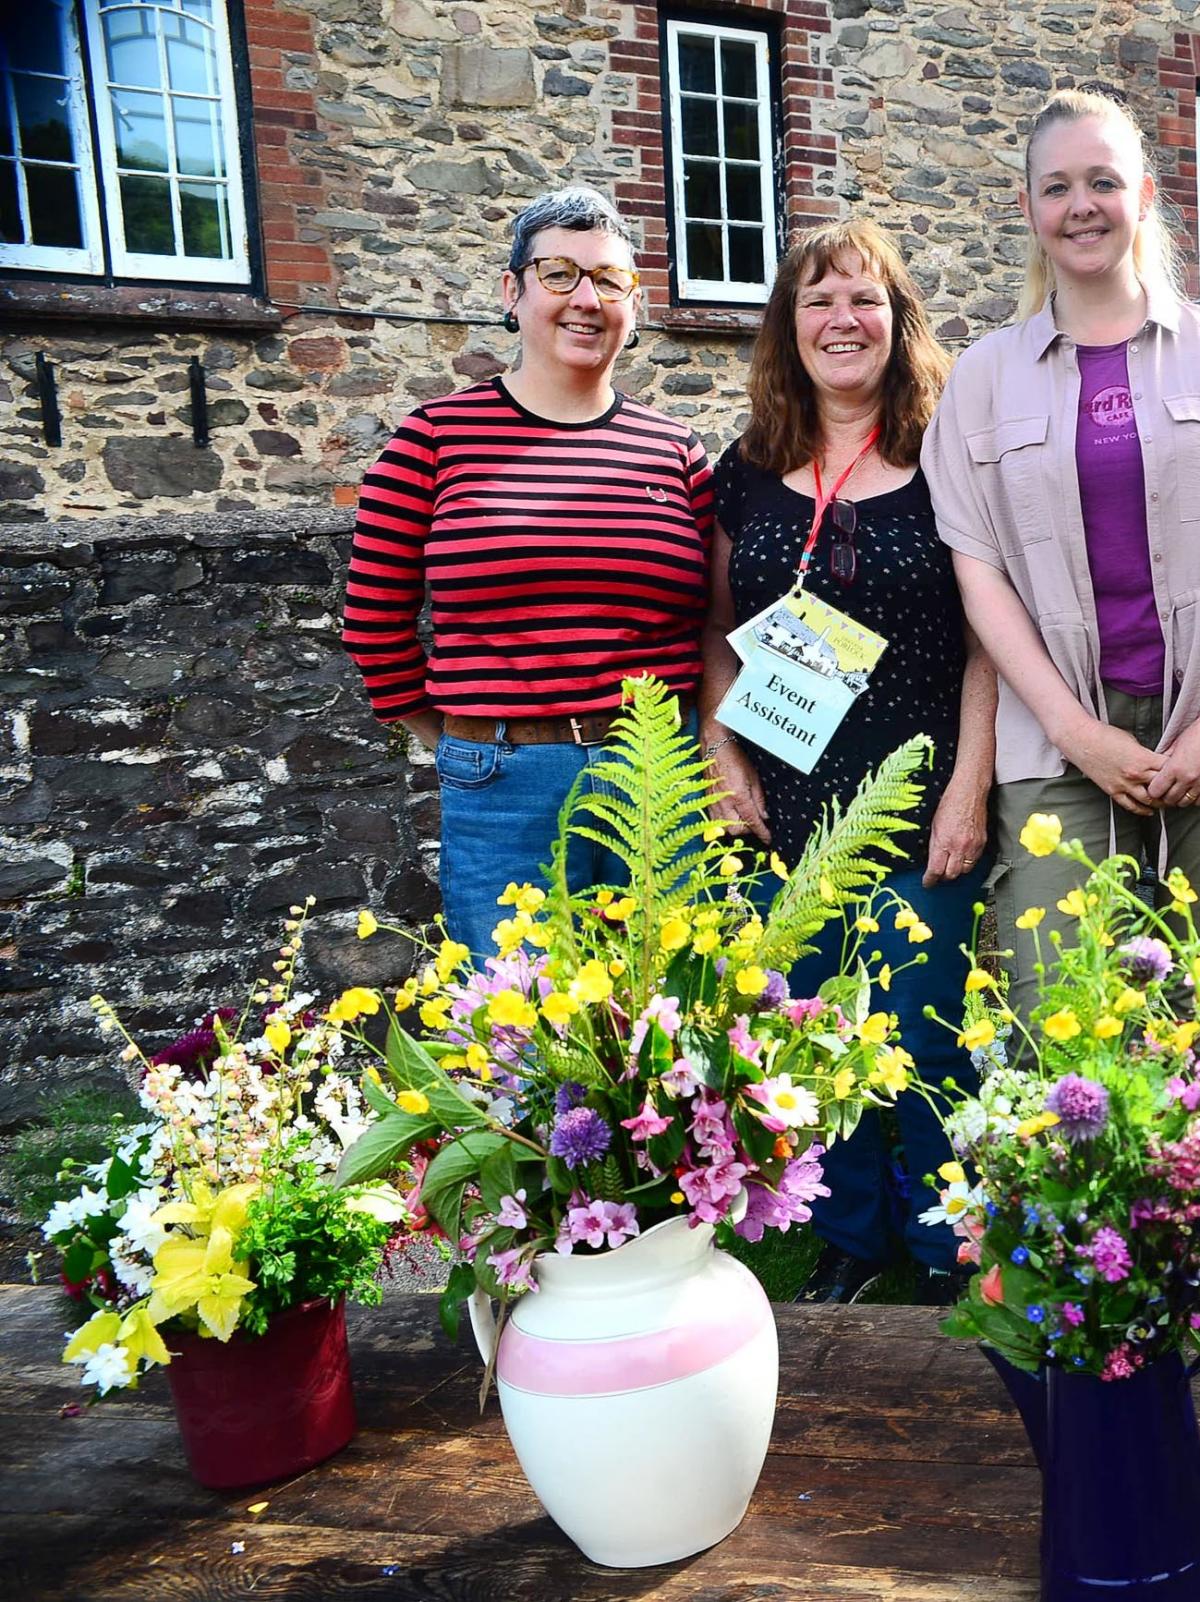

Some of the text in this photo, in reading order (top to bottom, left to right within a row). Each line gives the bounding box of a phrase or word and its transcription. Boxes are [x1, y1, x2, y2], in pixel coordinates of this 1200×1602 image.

[1116, 392, 1132, 409] R
[1094, 432, 1137, 445] NEW YO
[766, 673, 817, 714] Event
[736, 691, 817, 747] Assistant
